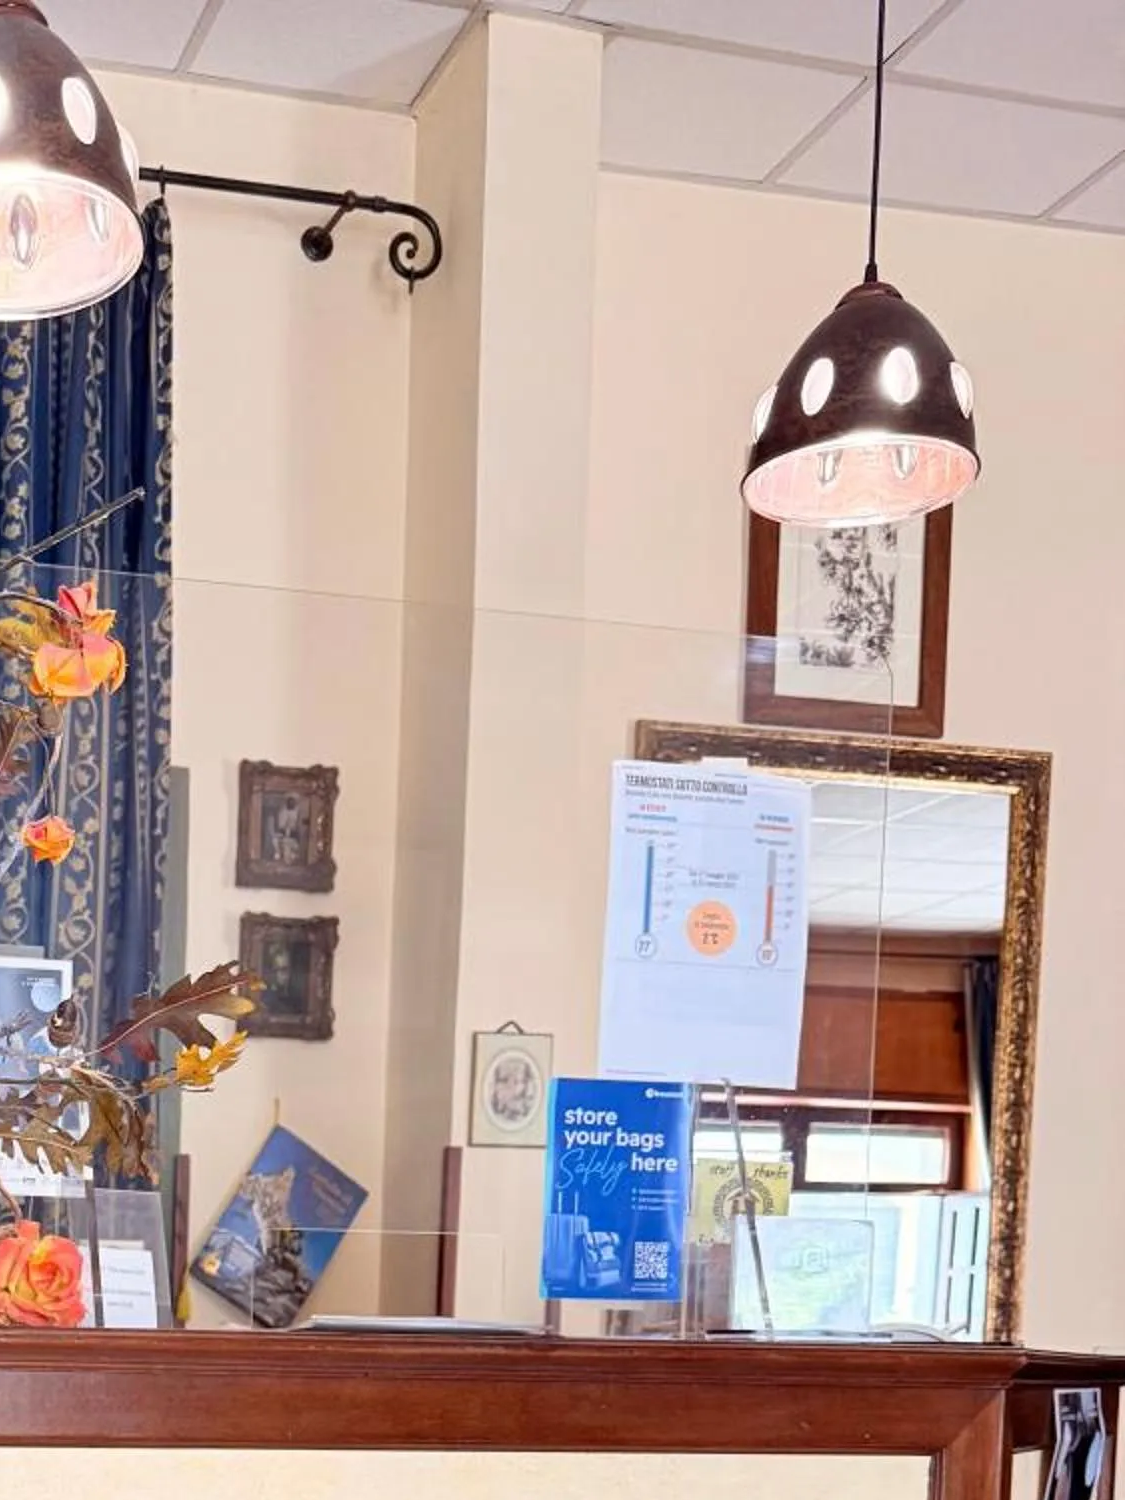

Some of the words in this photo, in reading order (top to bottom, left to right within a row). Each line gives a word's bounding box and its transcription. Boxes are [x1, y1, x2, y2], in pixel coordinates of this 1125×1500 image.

[564, 1107, 618, 1126] store
[564, 1129, 612, 1149] your
[616, 1127, 665, 1151] bags
[555, 1148, 627, 1196] Safely
[631, 1152, 678, 1172] here
